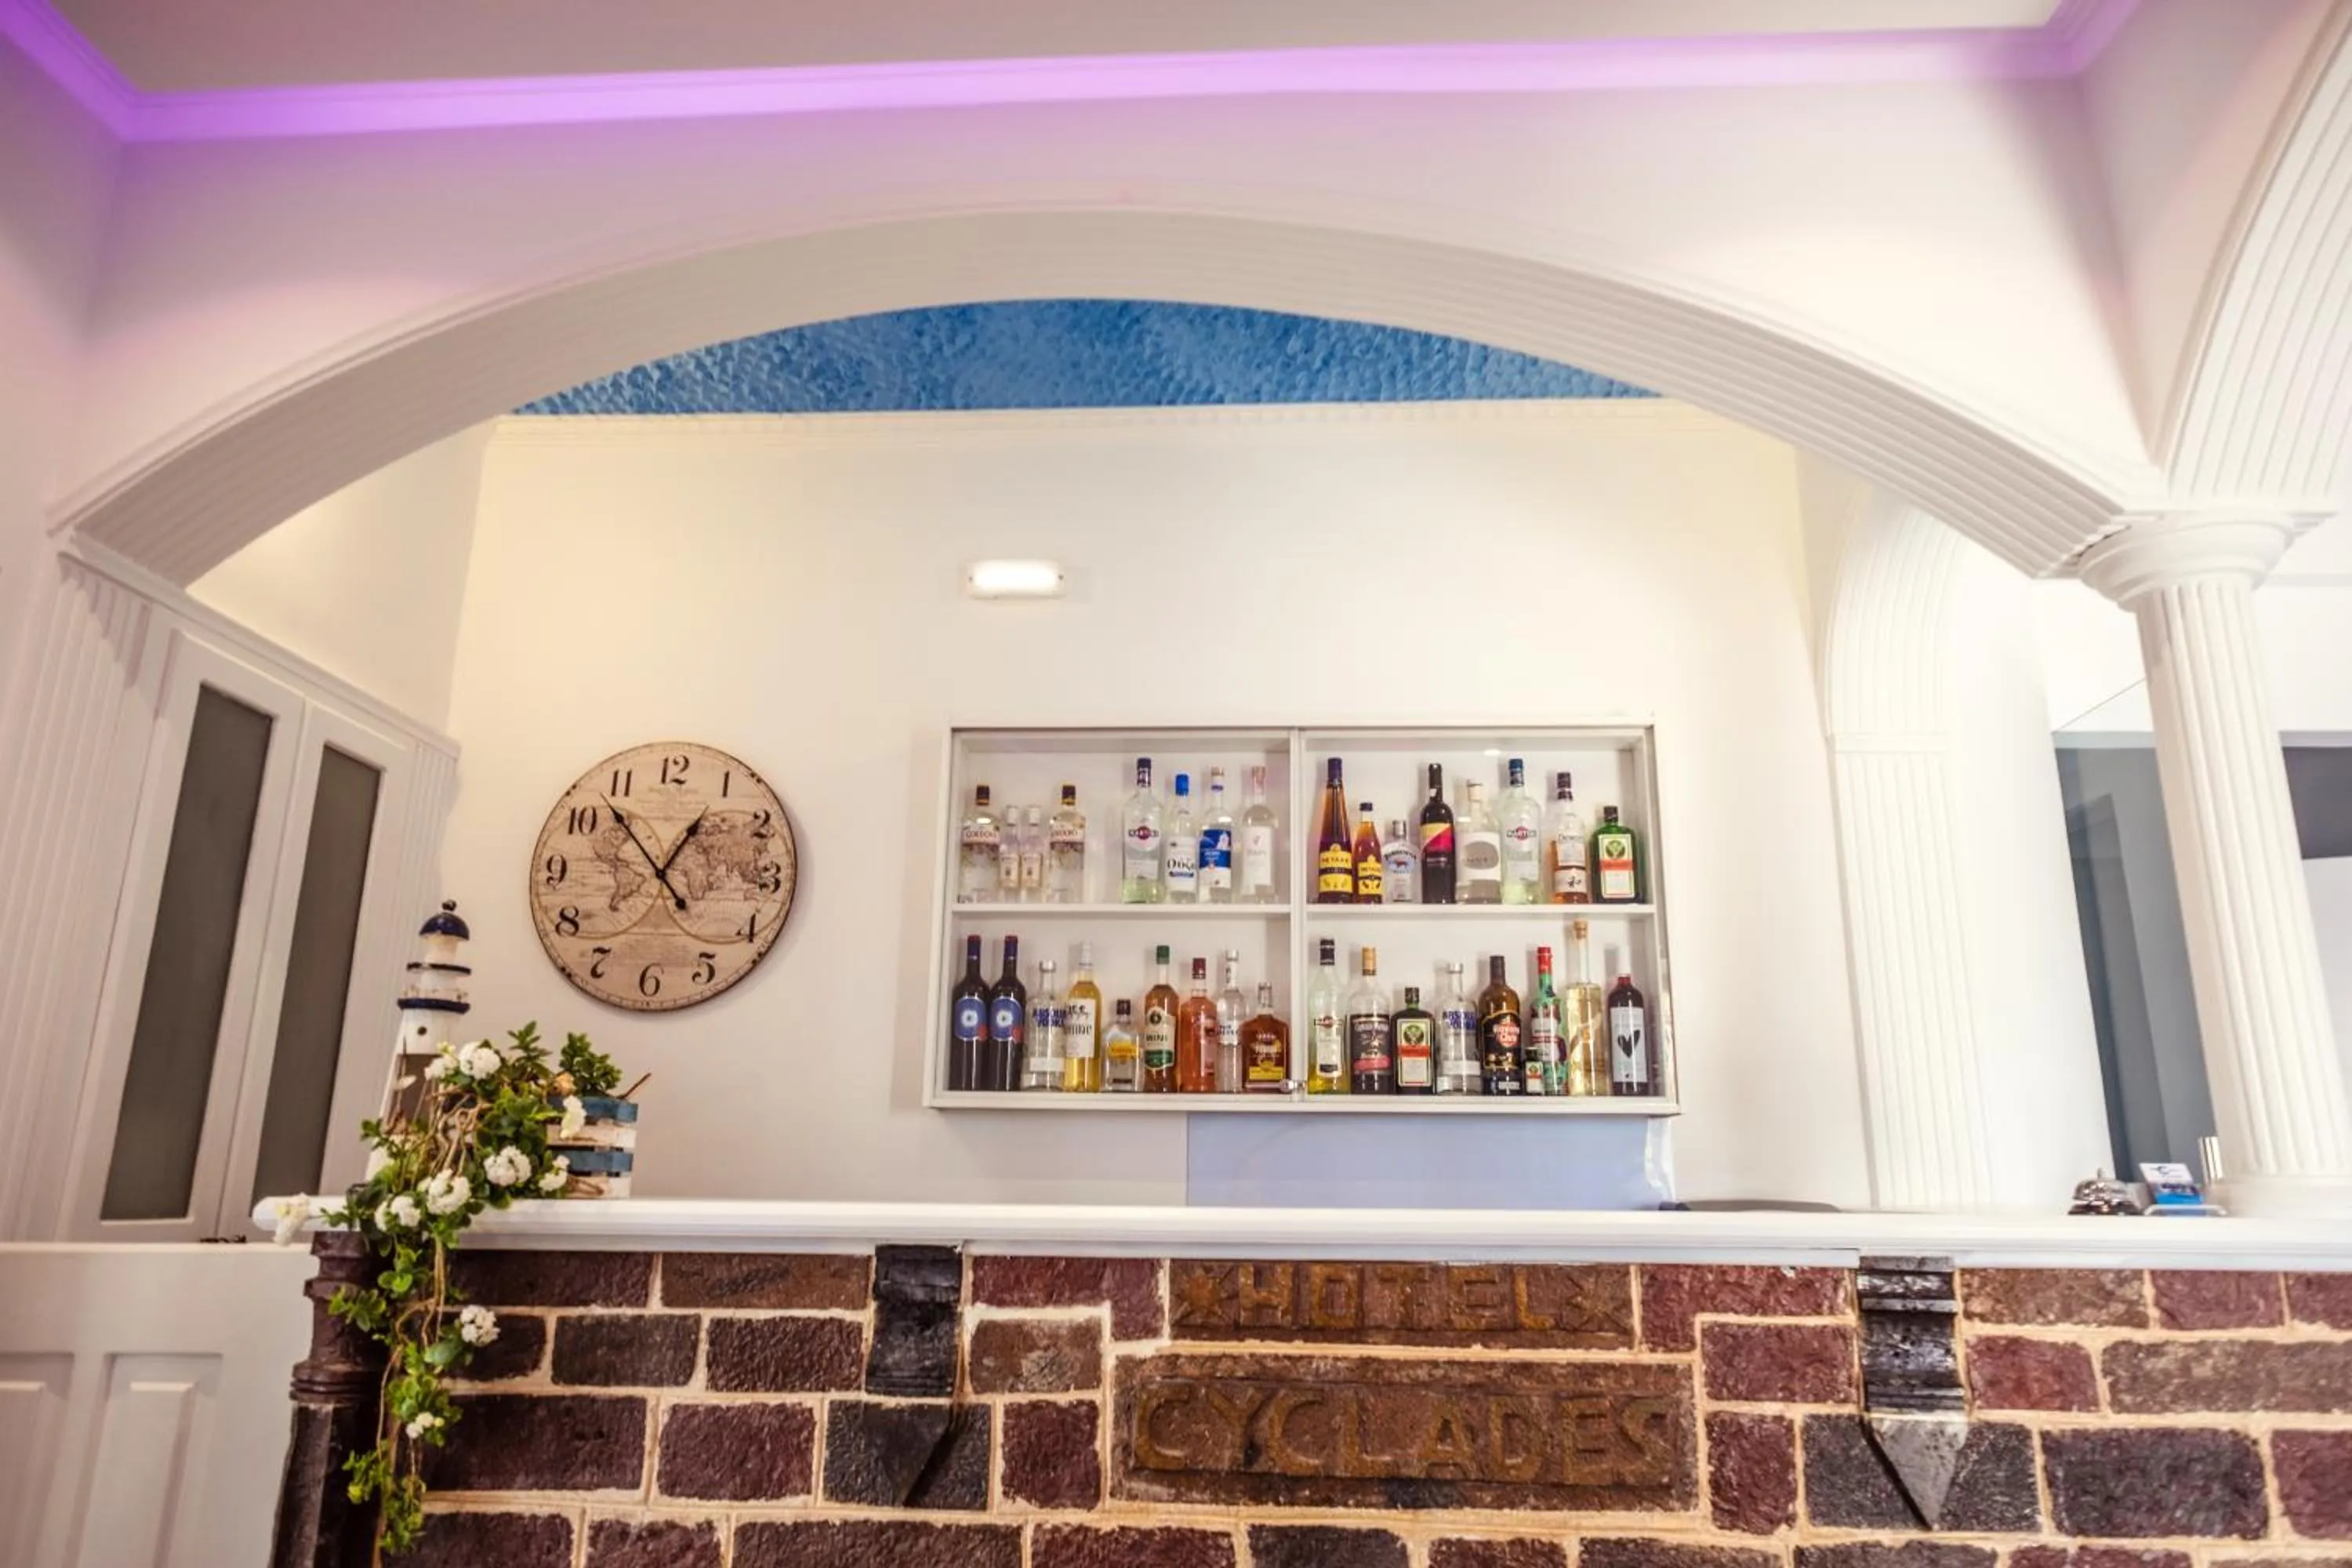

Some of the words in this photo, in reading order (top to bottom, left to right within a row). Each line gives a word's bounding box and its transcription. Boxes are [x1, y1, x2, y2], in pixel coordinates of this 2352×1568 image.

[611, 768, 633, 797] 11
[661, 754, 690, 785] 12
[722, 770, 731, 798] 1
[568, 805, 597, 836] 10
[753, 809, 775, 839] 2
[546, 853, 568, 887] 9
[758, 861, 782, 894] 3
[555, 905, 580, 937] 8
[735, 913, 757, 943] 4
[590, 946, 612, 979] 7
[691, 952, 716, 985] 5
[639, 962, 665, 996] 6
[1237, 1264, 1556, 1330] HOTEL
[1134, 1386, 1675, 1488] CYCLADES
